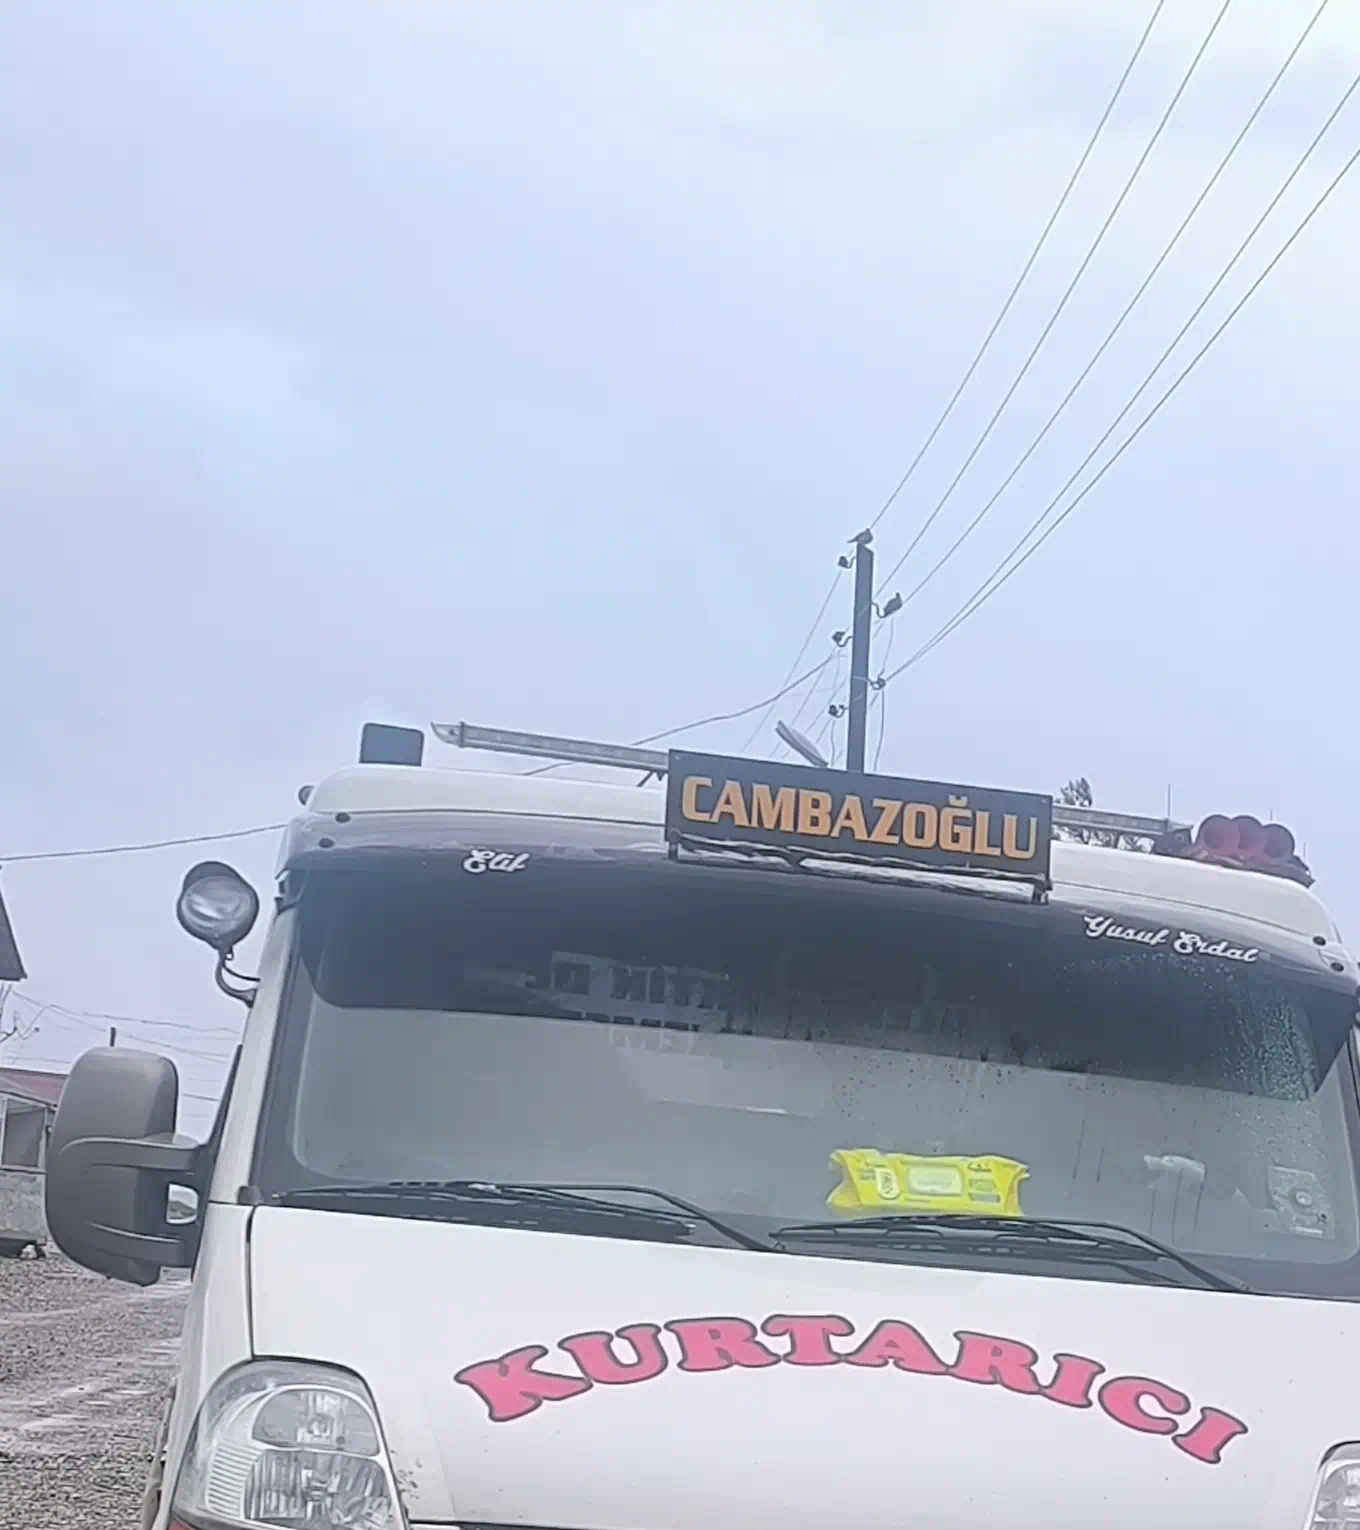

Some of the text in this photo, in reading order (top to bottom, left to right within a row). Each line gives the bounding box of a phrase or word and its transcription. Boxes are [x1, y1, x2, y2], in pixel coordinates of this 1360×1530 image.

[682, 776, 1038, 861] CAMBAZOĞLU
[463, 849, 530, 873] Elif
[1084, 915, 1260, 962] Yusuf Erdal
[454, 1314, 1249, 1464] KURTARICI
